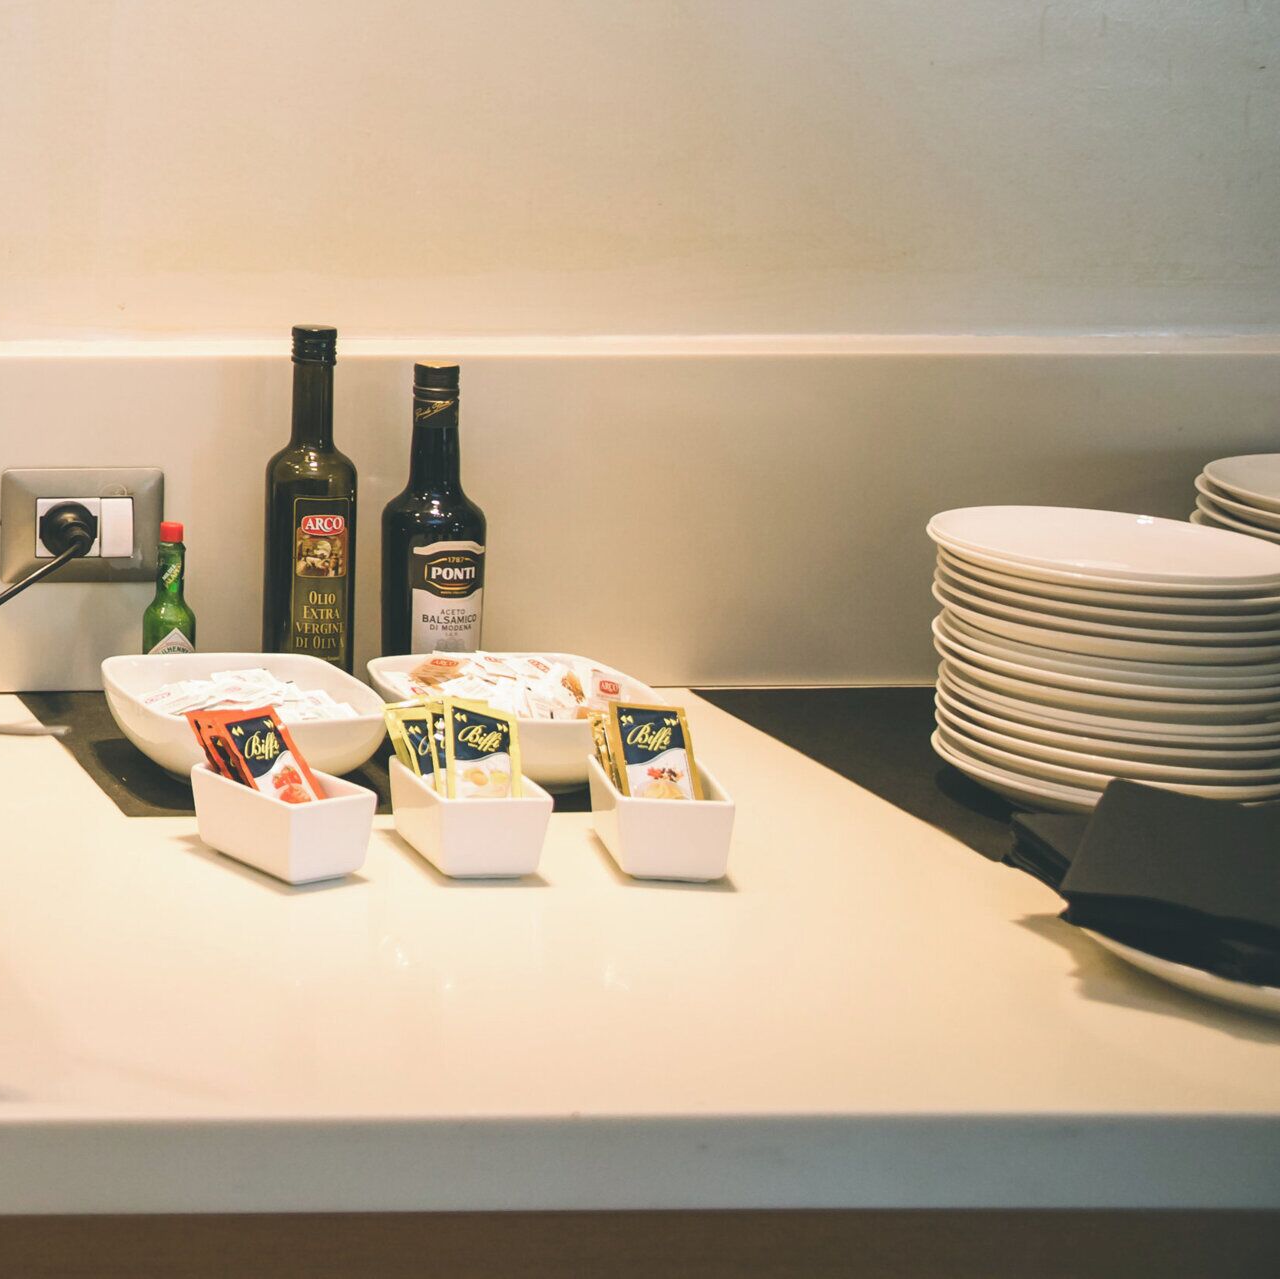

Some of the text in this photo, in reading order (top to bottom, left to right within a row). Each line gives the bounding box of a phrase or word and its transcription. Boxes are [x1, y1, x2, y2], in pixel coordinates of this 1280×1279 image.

[305, 517, 343, 532] ARCO
[430, 566, 476, 580] PONTI
[309, 591, 336, 605] OLIO
[303, 605, 340, 620] EXTRA
[422, 614, 477, 624] BALSAMICO
[296, 621, 344, 634] VERGINE
[296, 635, 344, 649] DI OLIVA
[458, 725, 502, 752] Biffi
[626, 722, 673, 752] Biffi
[244, 731, 280, 760] Biffi
